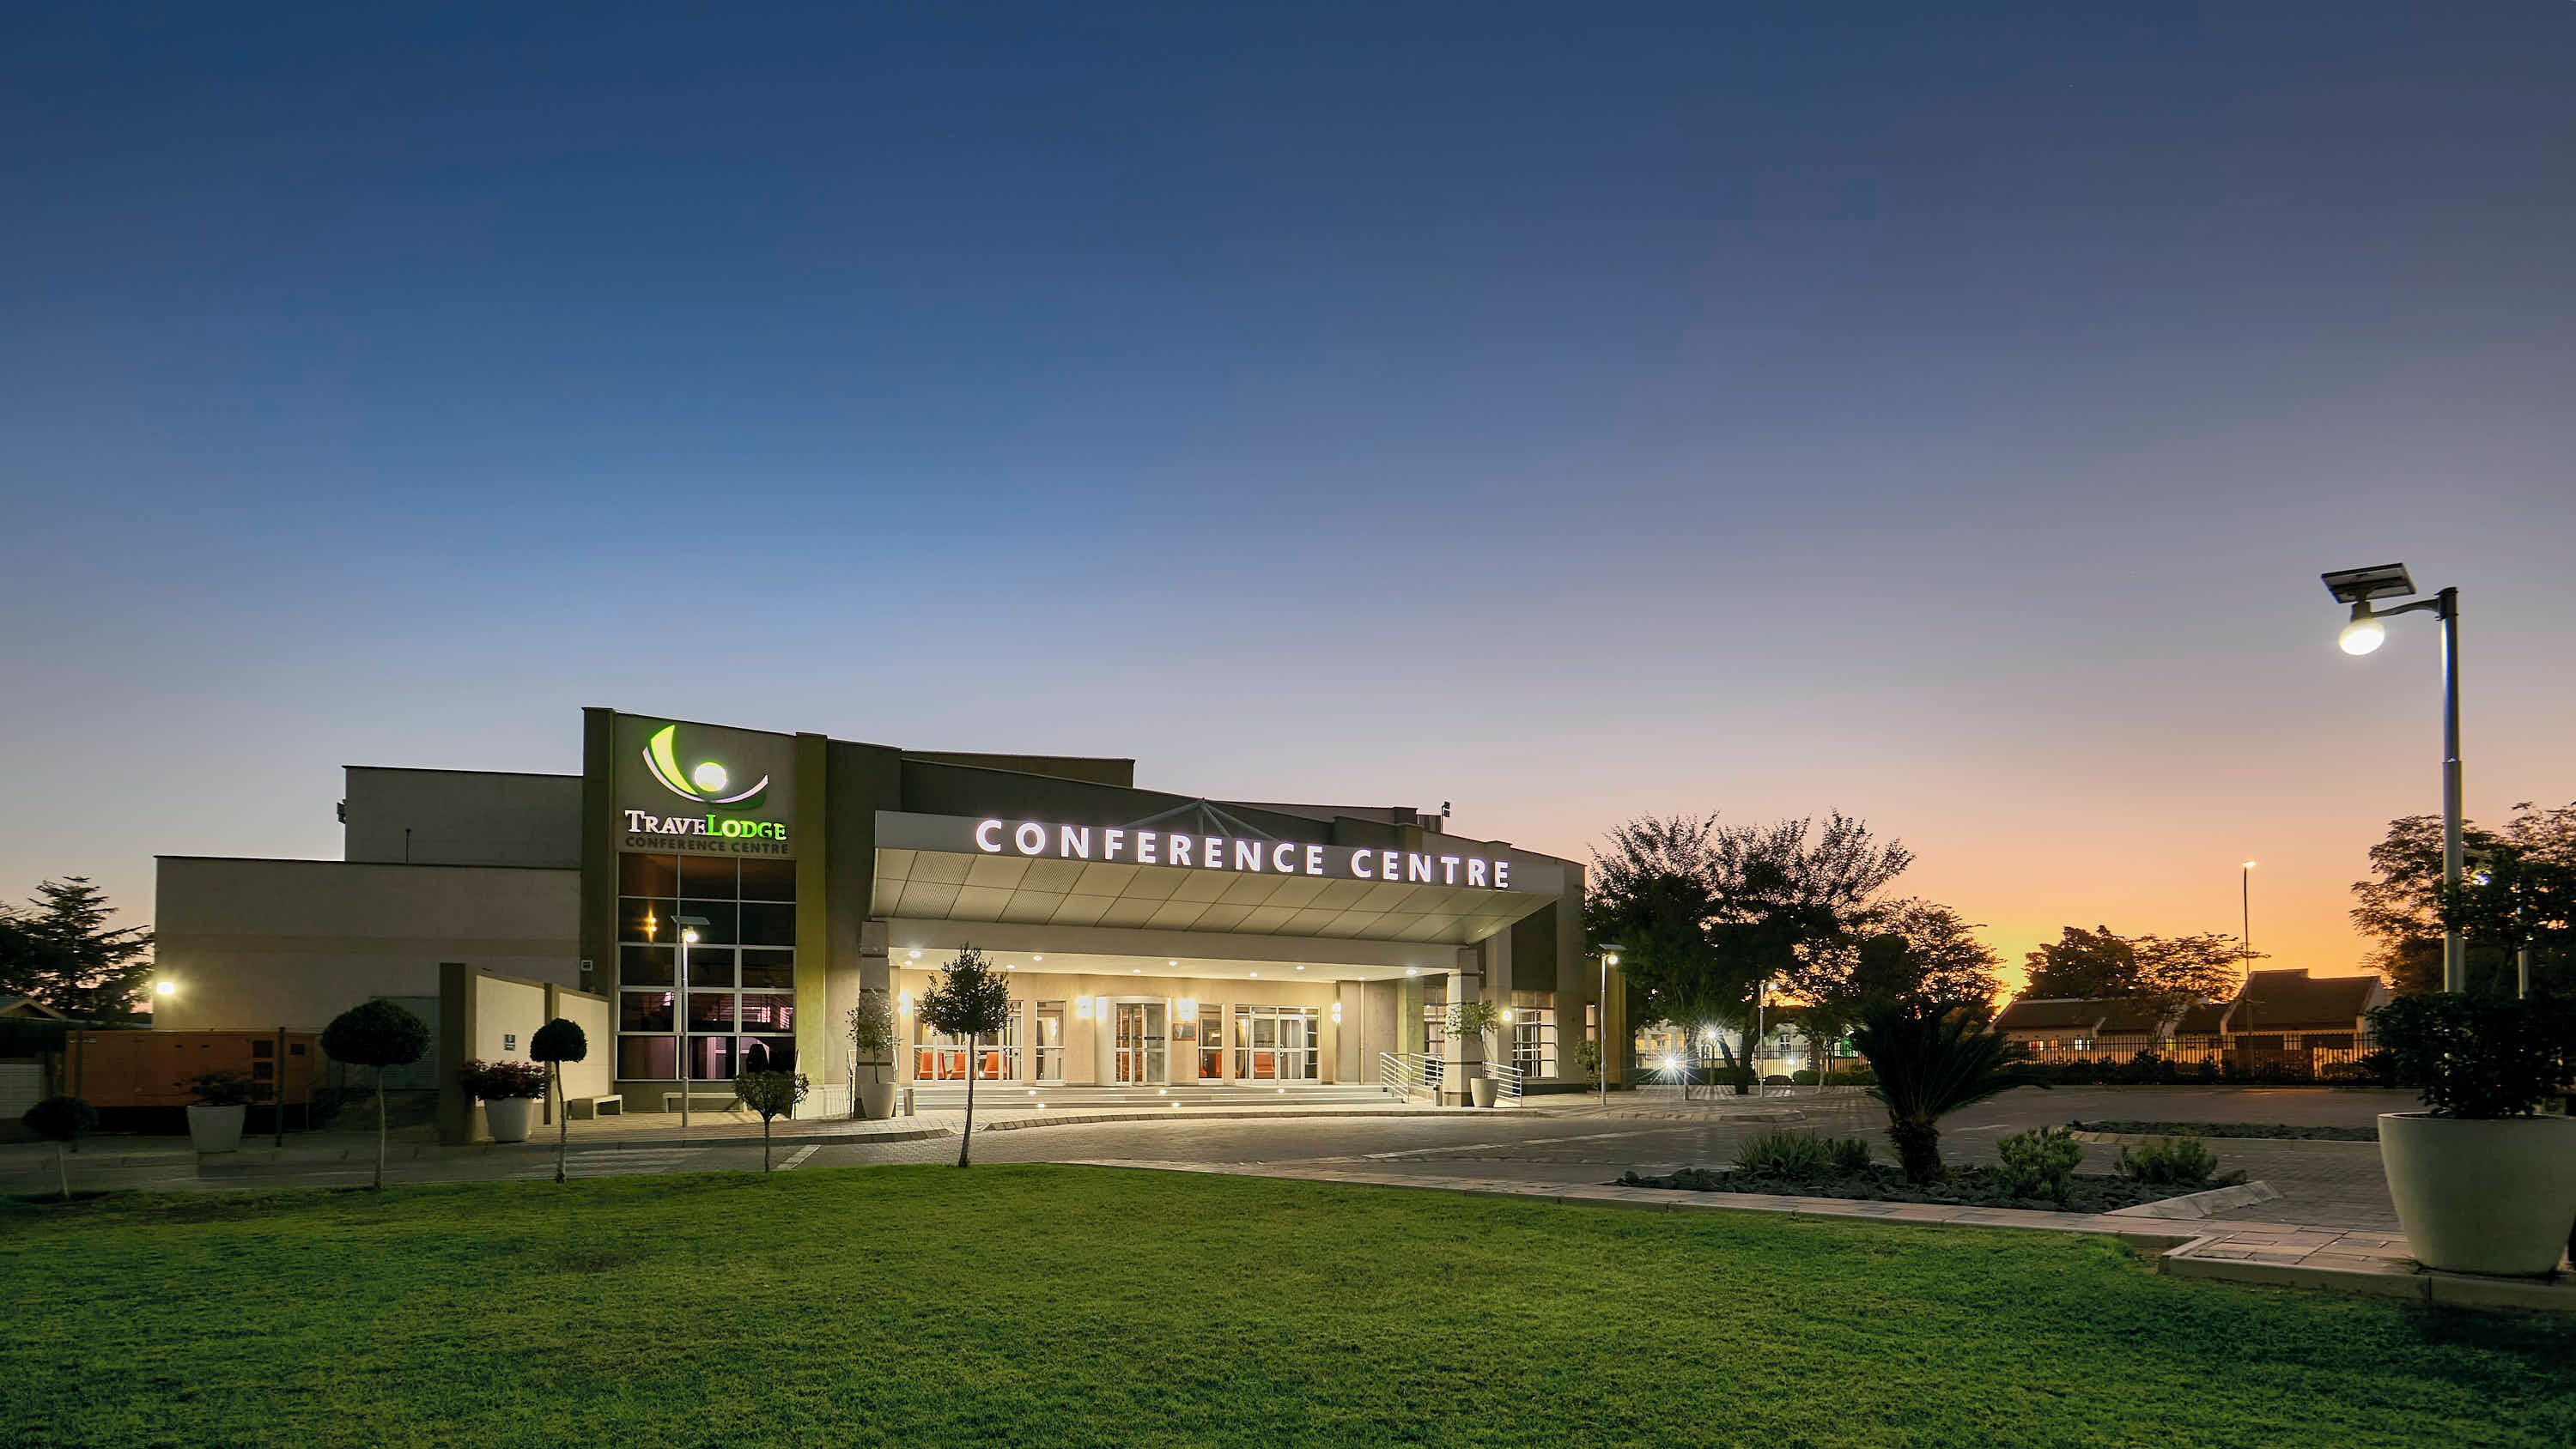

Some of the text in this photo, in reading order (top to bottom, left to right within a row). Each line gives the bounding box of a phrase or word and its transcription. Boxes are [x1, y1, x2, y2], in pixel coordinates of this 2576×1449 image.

[624, 809, 787, 840] TRAVELODGE
[625, 836, 789, 855] CONFERENCE CENTRE
[975, 819, 1509, 888] CONFERENCE CENTRE
